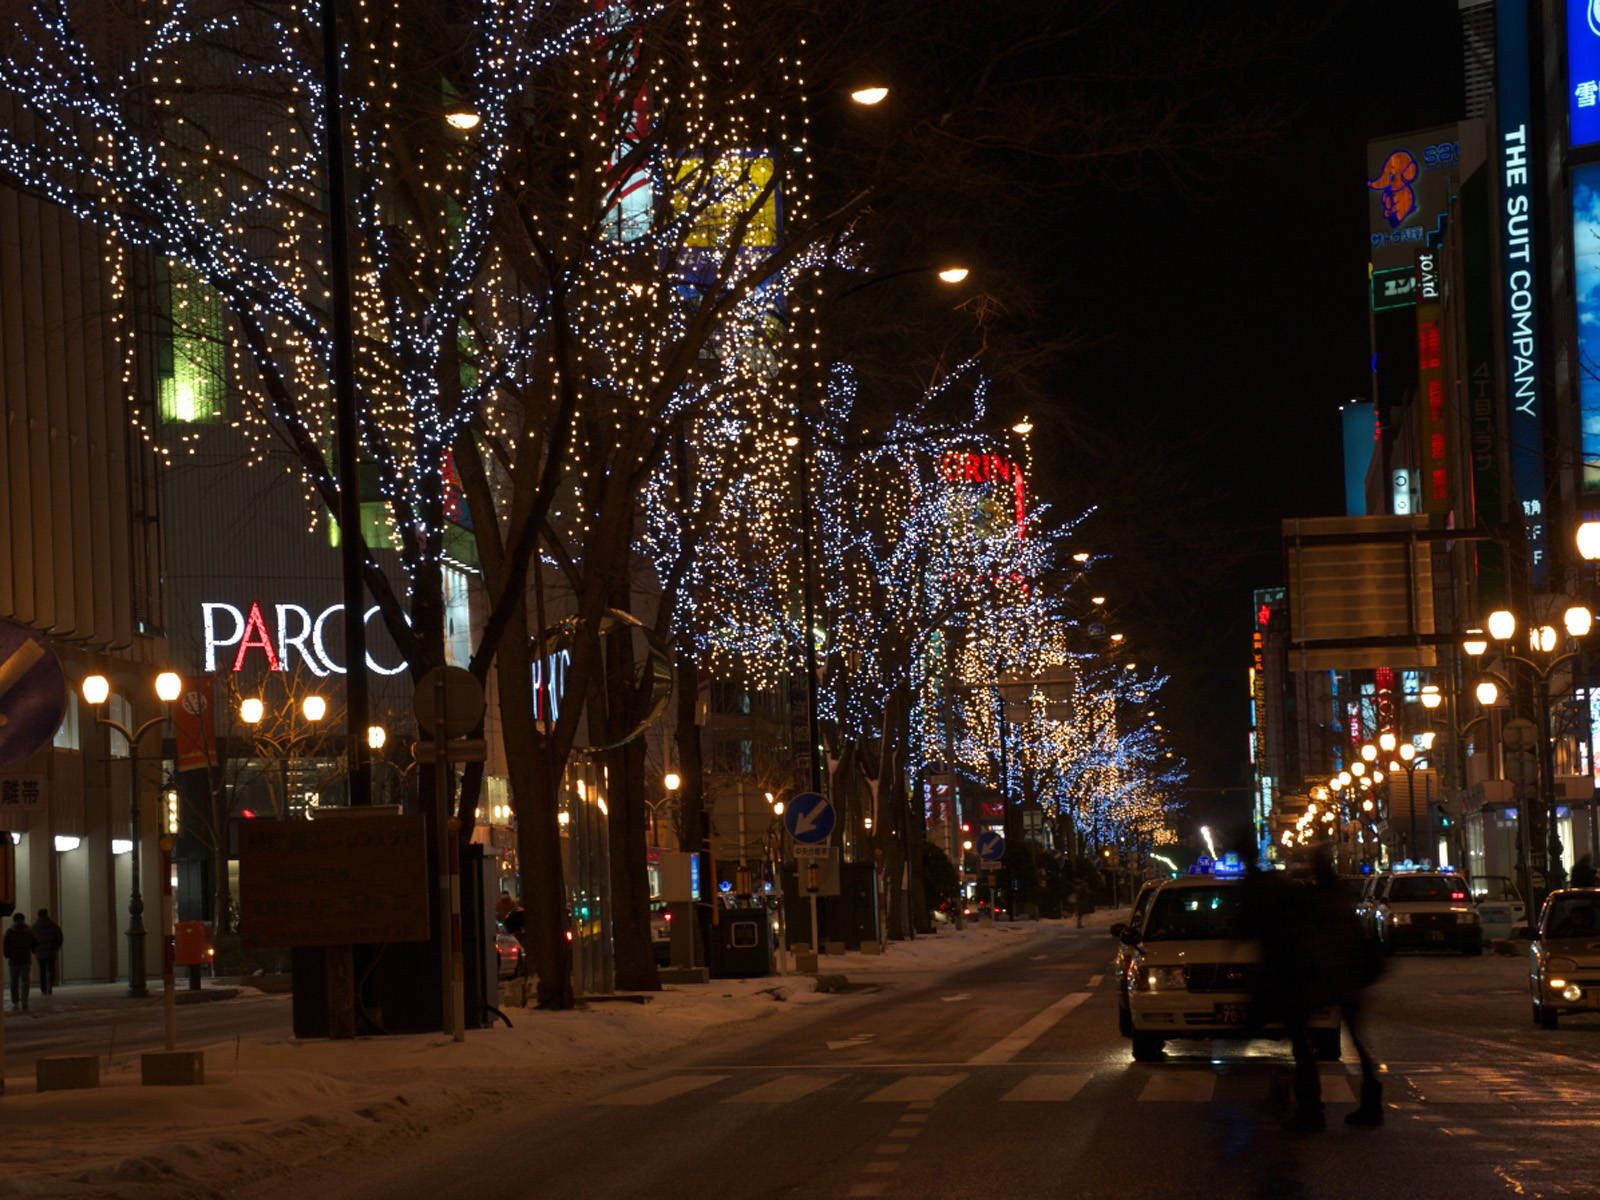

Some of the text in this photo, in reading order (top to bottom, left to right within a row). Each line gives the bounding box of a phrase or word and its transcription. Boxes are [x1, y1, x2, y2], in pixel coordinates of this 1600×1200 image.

[1574, 79, 1600, 109] 雪
[1418, 253, 1440, 298] pivot
[1504, 124, 1537, 417] THE SUIT COMPANY
[201, 601, 412, 677] PARCO
